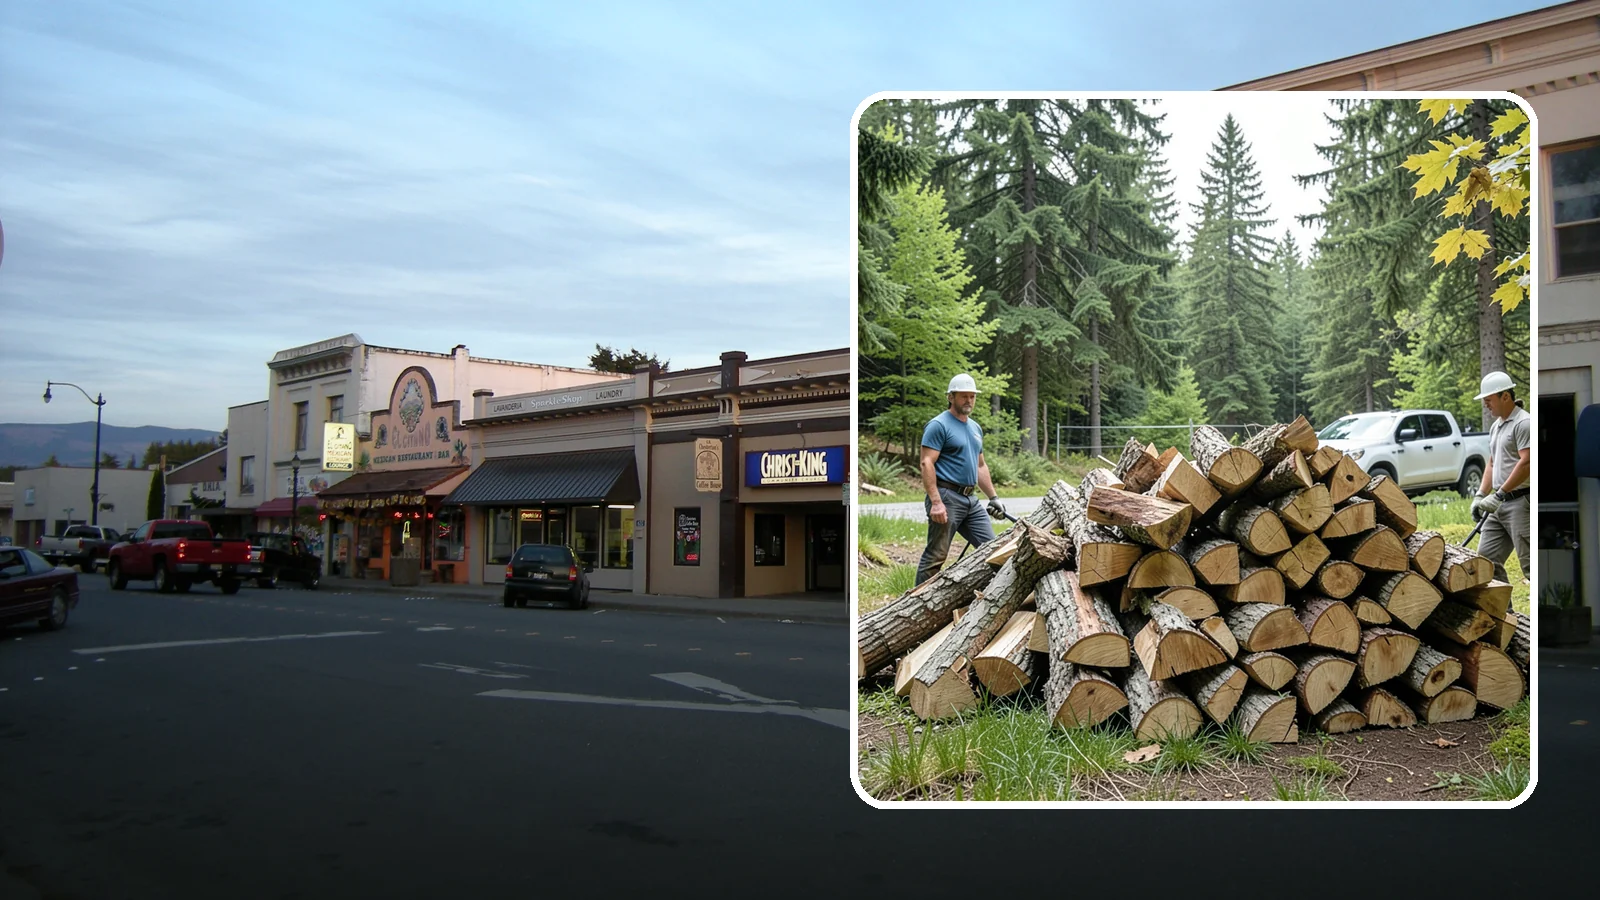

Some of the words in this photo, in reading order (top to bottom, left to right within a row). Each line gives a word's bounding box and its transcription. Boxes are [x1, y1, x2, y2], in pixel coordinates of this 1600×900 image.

[596, 388, 623, 400] LAUNDRY
[493, 402, 522, 413] LAVANDERIA
[530, 398, 560, 410] Sparkle
[561, 394, 582, 405] Shop
[373, 455, 396, 464] MEXICAN
[397, 451, 433, 462] RESTAURANT
[438, 450, 450, 459] BAR
[761, 452, 798, 478] CHRIST
[799, 450, 827, 476] KING
